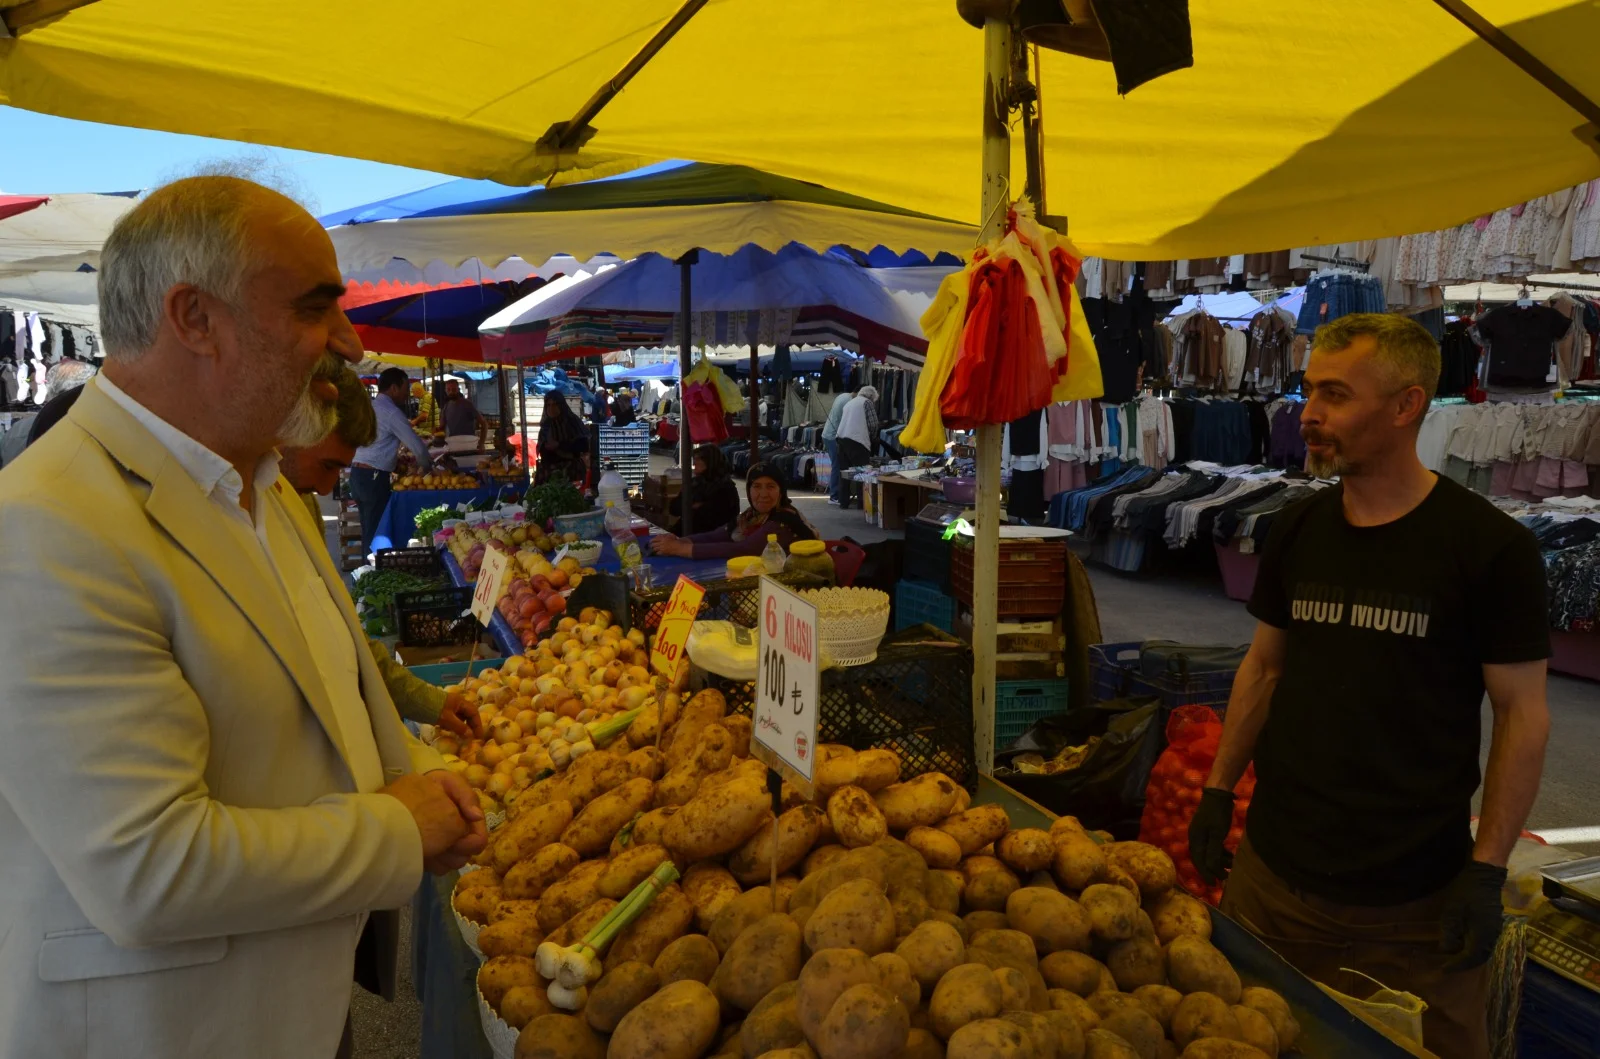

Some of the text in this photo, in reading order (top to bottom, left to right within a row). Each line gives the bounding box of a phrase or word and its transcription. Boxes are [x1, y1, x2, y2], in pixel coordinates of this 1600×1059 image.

[475, 568, 493, 605] 20
[666, 582, 684, 614] 3
[766, 594, 777, 639] 6
[652, 626, 677, 660] 100
[764, 644, 785, 707] 100
